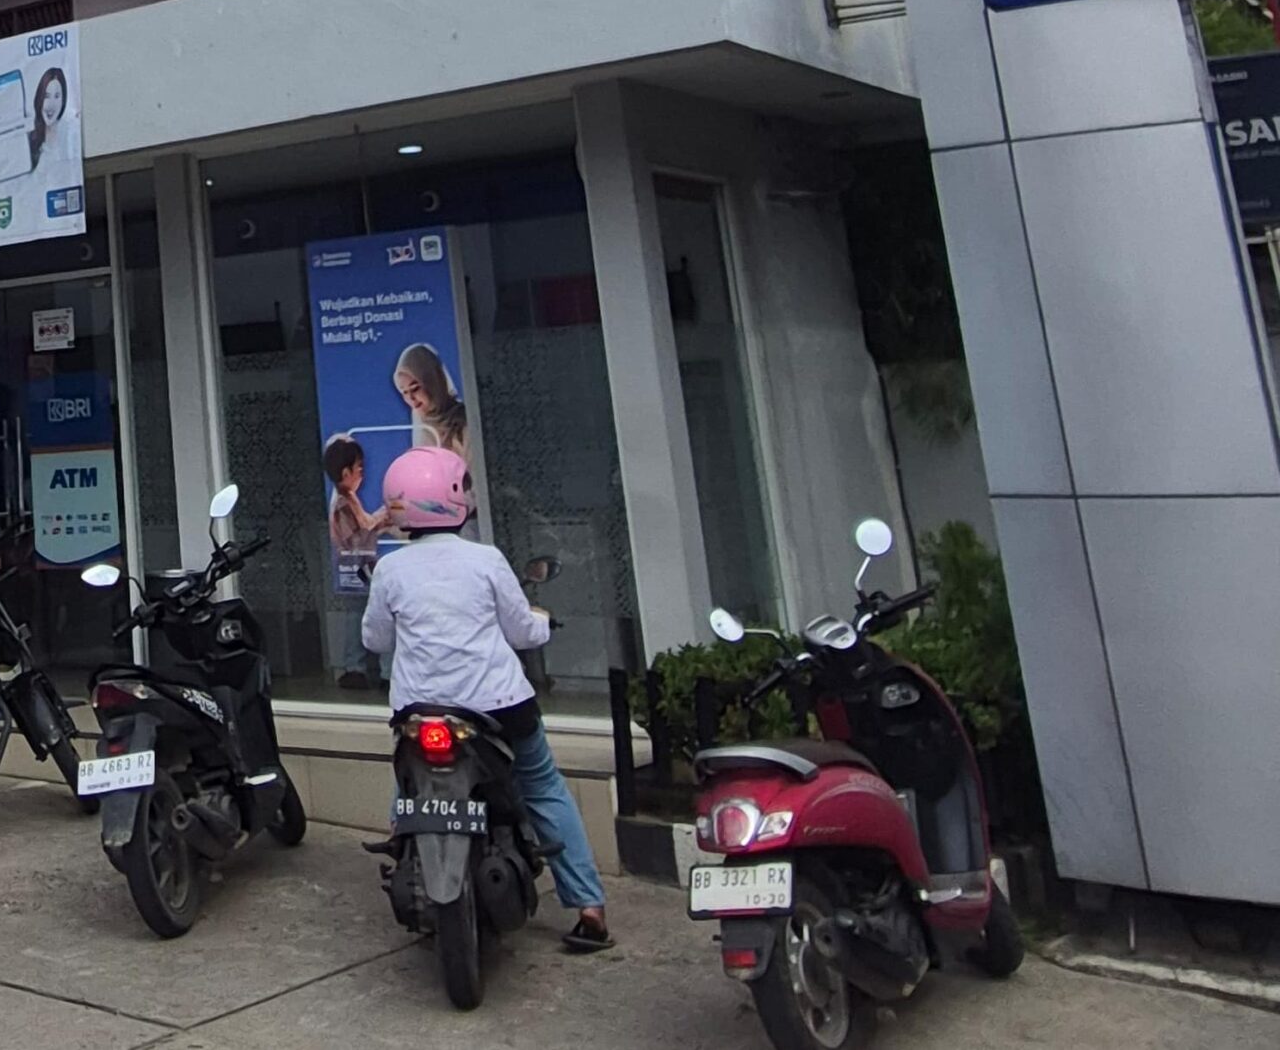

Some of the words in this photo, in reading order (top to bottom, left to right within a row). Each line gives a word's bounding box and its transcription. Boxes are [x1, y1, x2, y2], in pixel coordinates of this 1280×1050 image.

[44, 30, 68, 52] BRI
[1225, 115, 1280, 147] SA
[65, 396, 92, 419] BRI
[49, 467, 98, 490] ATM
[80, 763, 94, 777] BB
[138, 753, 152, 769] RZ
[397, 799, 415, 815] BB
[422, 799, 457, 815] 4704
[467, 800, 486, 816] RK
[694, 871, 711, 889] BB
[721, 869, 757, 887] 3321
[767, 867, 786, 885] RX
